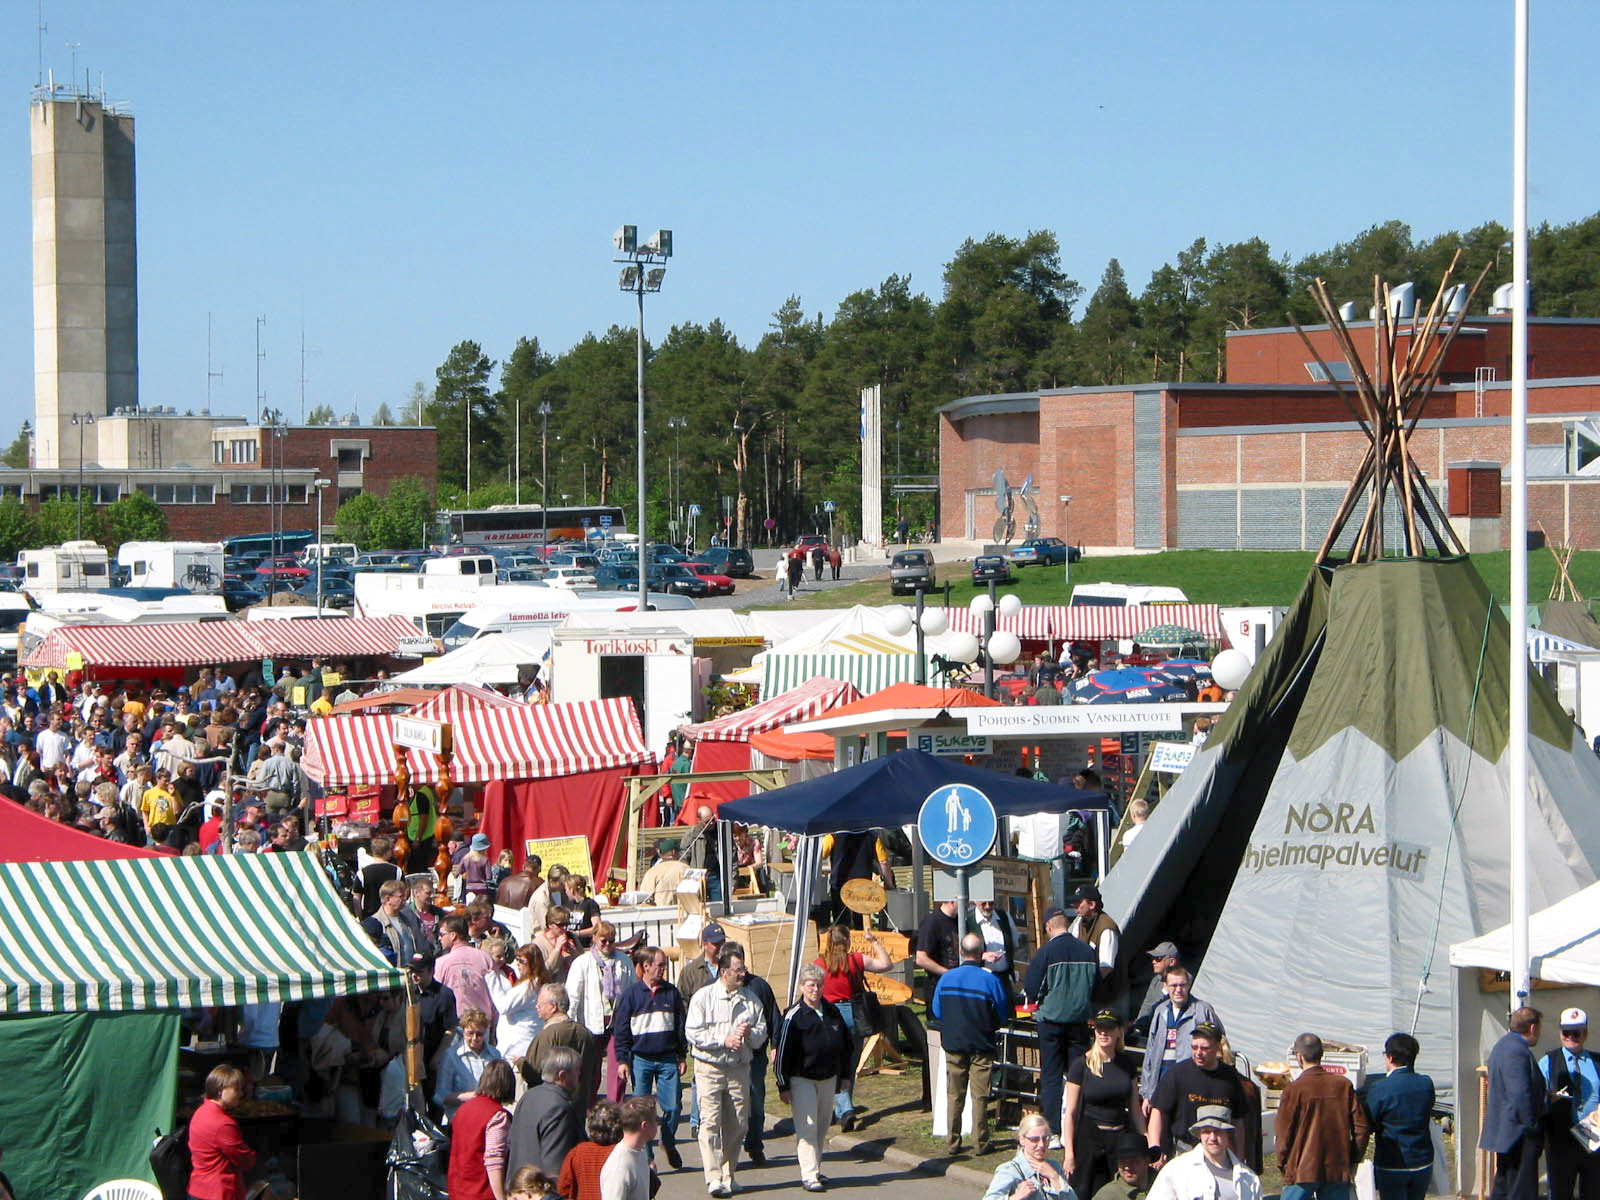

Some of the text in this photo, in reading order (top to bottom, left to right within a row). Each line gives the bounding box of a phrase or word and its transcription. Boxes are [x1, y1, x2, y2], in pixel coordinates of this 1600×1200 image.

[551, 611, 569, 619] leiv
[584, 639, 657, 654] Torikioski
[1086, 712, 1171, 725] VANKILATUOTE
[1241, 841, 1426, 874] hjelmapalvelut
